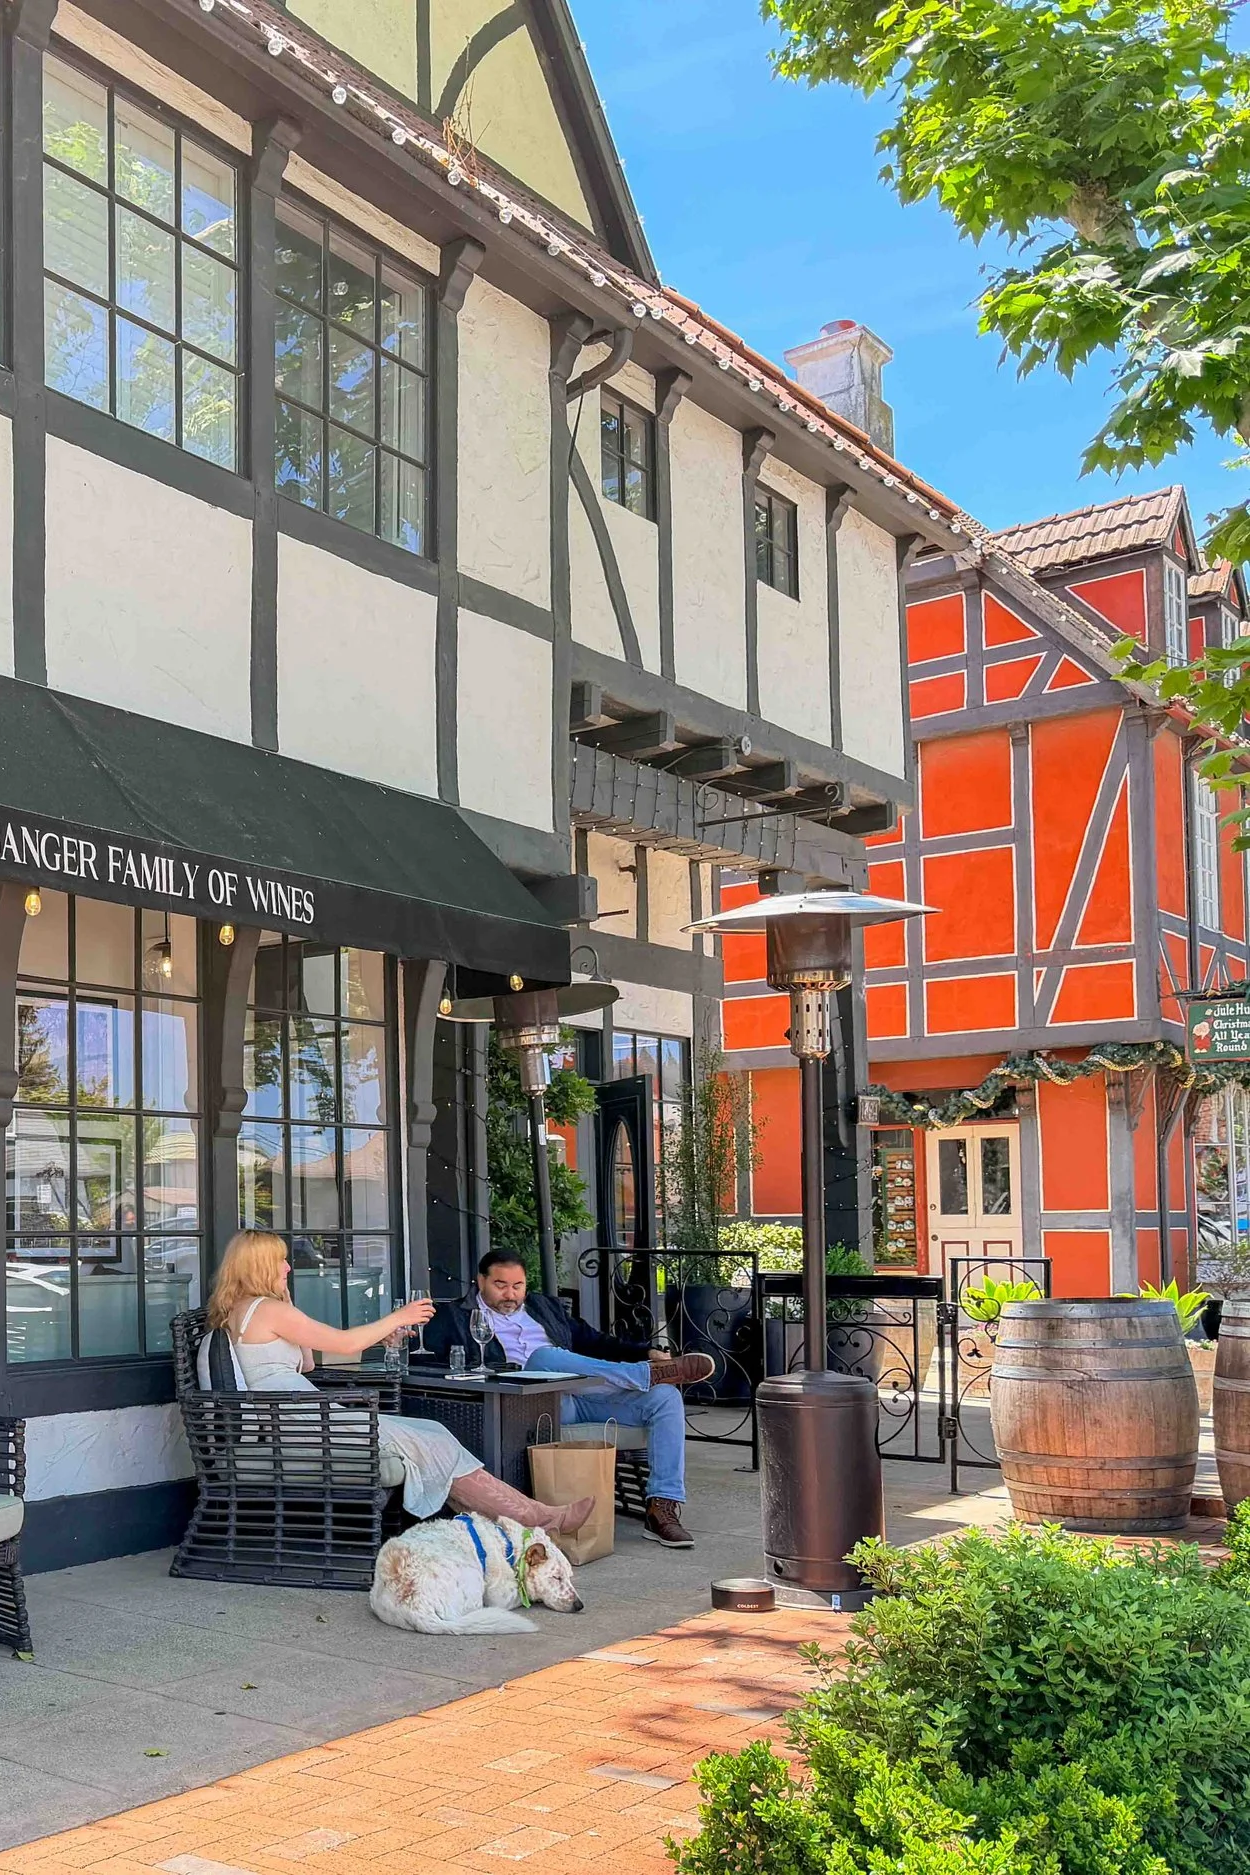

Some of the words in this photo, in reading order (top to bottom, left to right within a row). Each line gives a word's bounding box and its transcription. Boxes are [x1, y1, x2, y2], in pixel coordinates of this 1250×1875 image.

[107, 845, 200, 900] FAMILY
[208, 868, 238, 907] OF
[245, 875, 316, 924] WINES
[1213, 1004, 1234, 1016] Jule
[1211, 1031, 1227, 1042] All
[1216, 1040, 1248, 1052] Round
